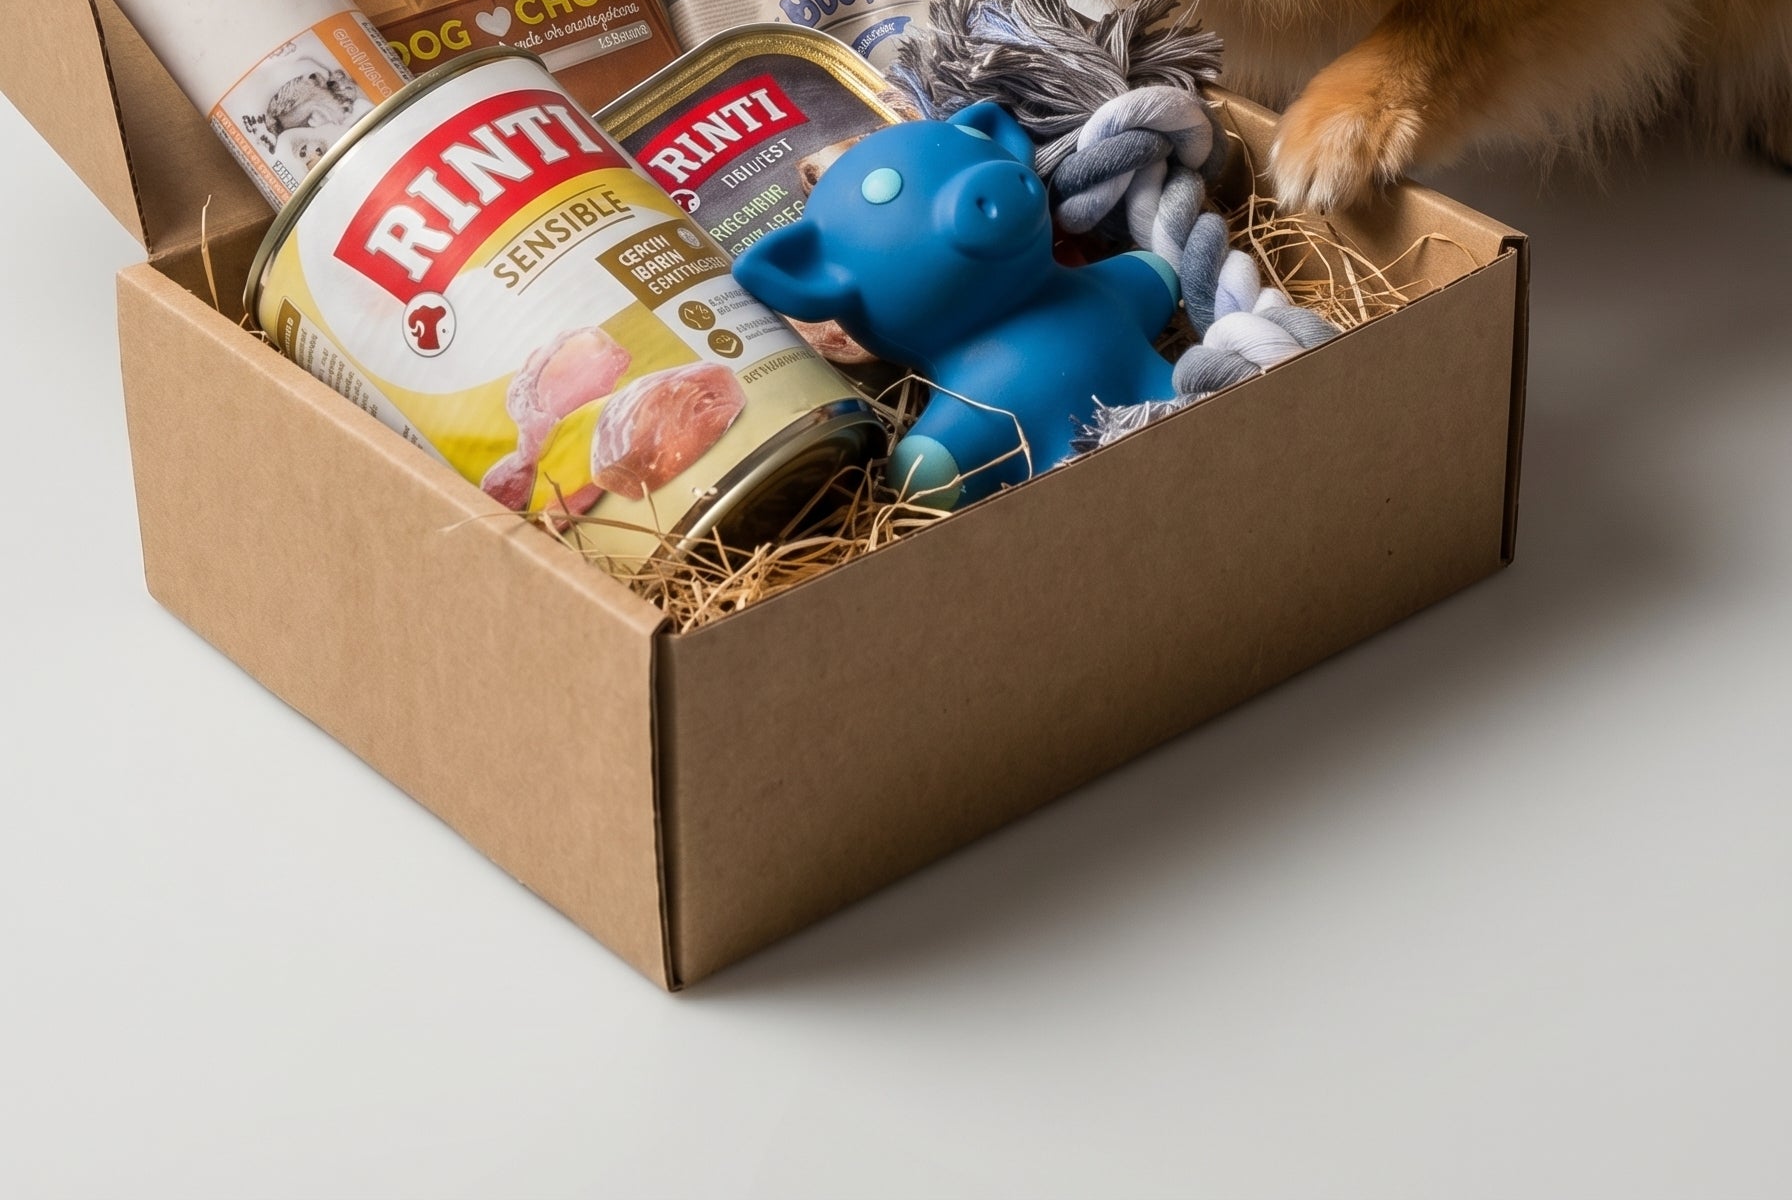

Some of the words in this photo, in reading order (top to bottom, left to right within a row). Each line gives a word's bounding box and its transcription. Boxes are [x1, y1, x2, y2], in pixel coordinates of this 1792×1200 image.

[647, 87, 788, 184] RINTI
[363, 103, 604, 284] RINTI
[493, 190, 631, 289] SENSIBLE
